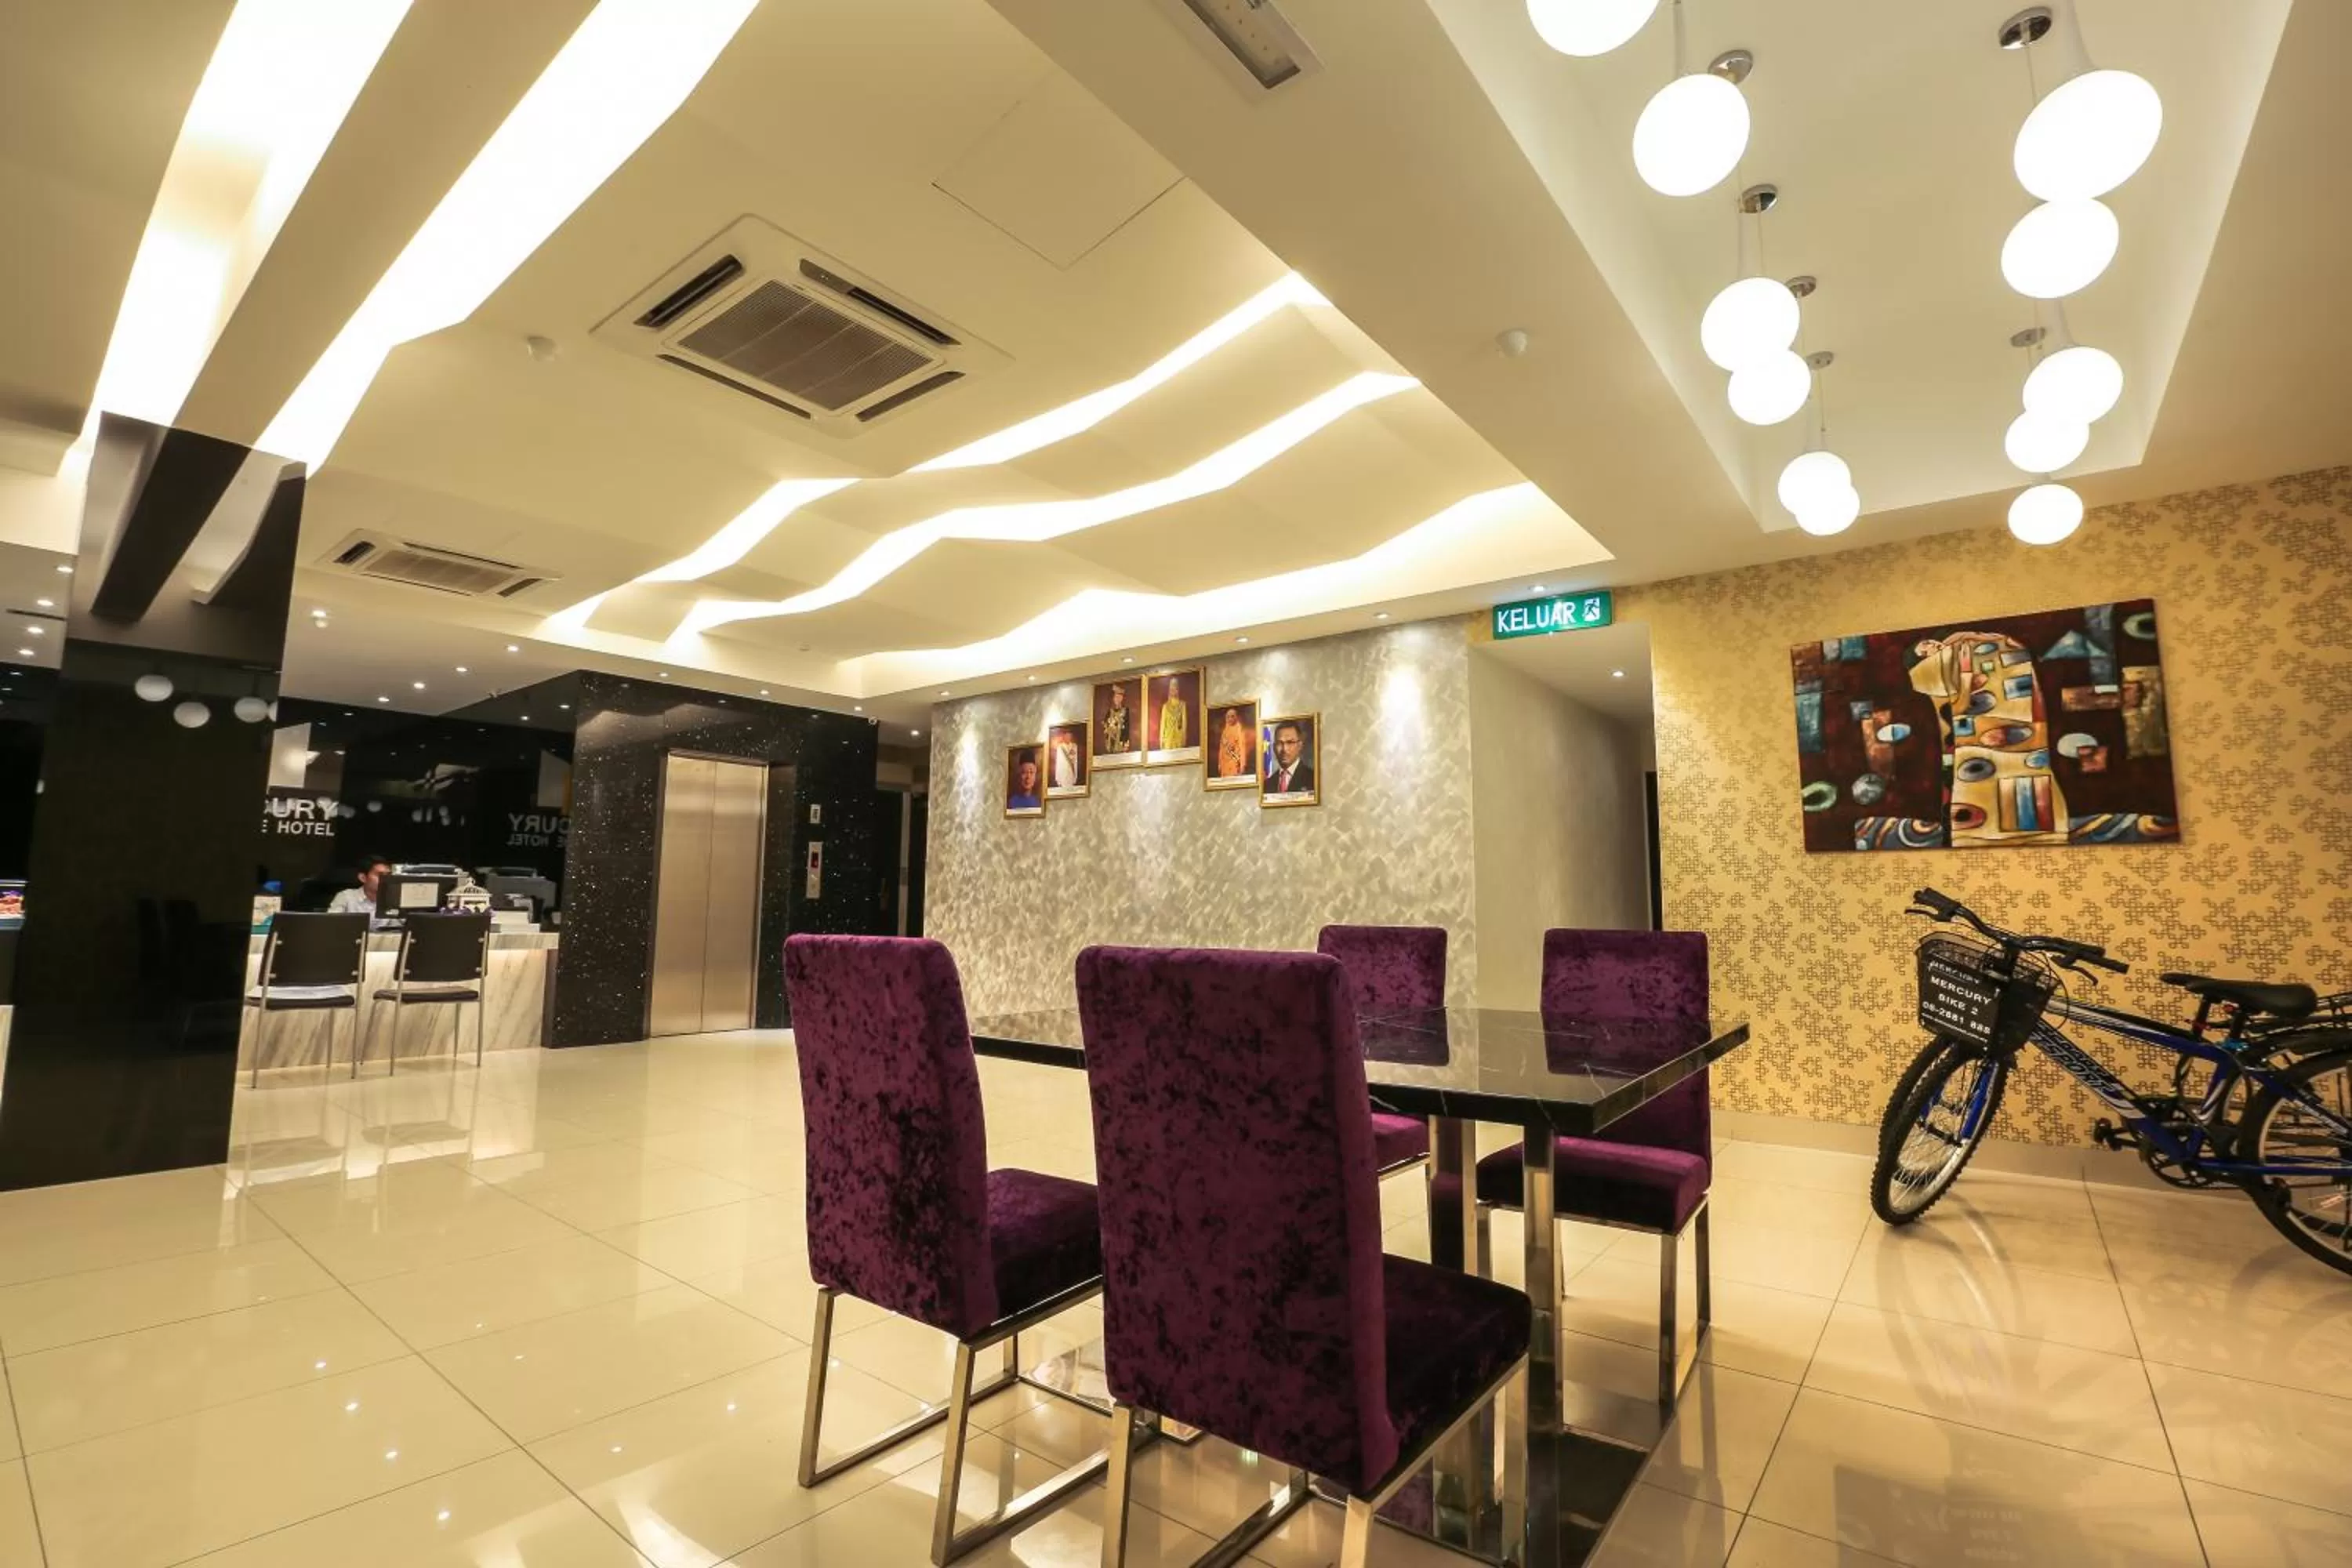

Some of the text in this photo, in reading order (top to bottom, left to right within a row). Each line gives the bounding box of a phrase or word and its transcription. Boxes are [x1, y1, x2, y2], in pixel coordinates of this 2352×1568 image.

[1497, 602, 1576, 633] KELUAR
[263, 797, 339, 821] URY
[277, 820, 335, 837] HOTEL
[1930, 975, 1992, 1004] MERCURY
[1938, 993, 1979, 1016] BIKE 2
